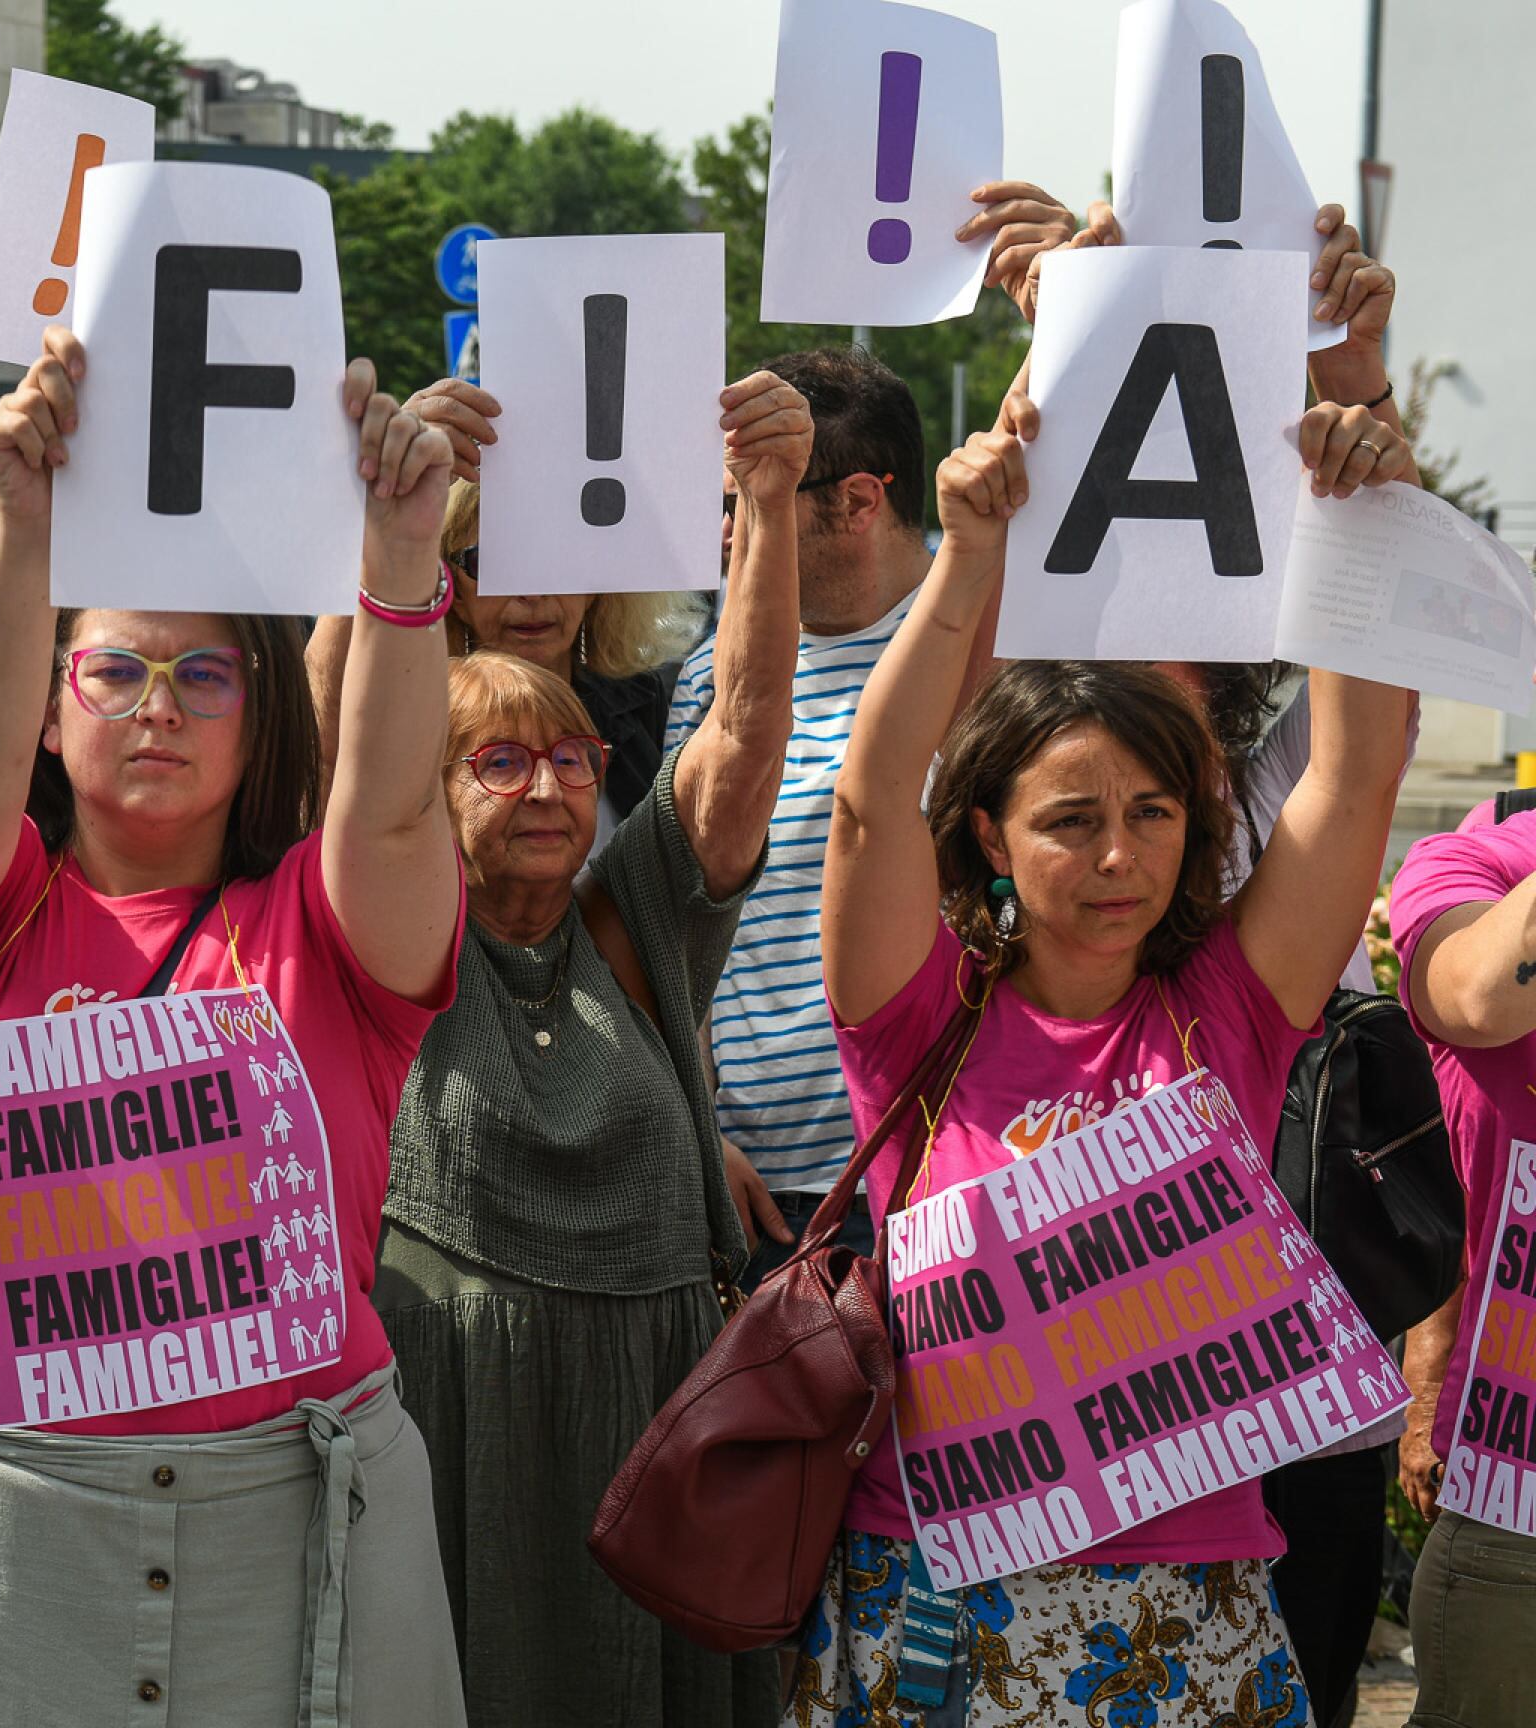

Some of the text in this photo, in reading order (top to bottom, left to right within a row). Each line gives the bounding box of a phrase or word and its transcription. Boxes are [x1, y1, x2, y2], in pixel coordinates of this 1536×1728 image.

[147, 244, 303, 516] F
[1043, 323, 1264, 577] A
[5, 1236, 270, 1348] FAMIGLIE!
[891, 1088, 1210, 1283] SIAMO FAMIGLIE!
[893, 1156, 1254, 1360] SIAMO FAMIGLIE!
[16, 1310, 281, 1424] FAMIGLIE!
[895, 1227, 1295, 1440] SIAMO FAMIGLIE!
[905, 1299, 1330, 1518] SIAMO FAMIGLIE!
[920, 1368, 1364, 1590] SIAMO FAMIGLIE!
